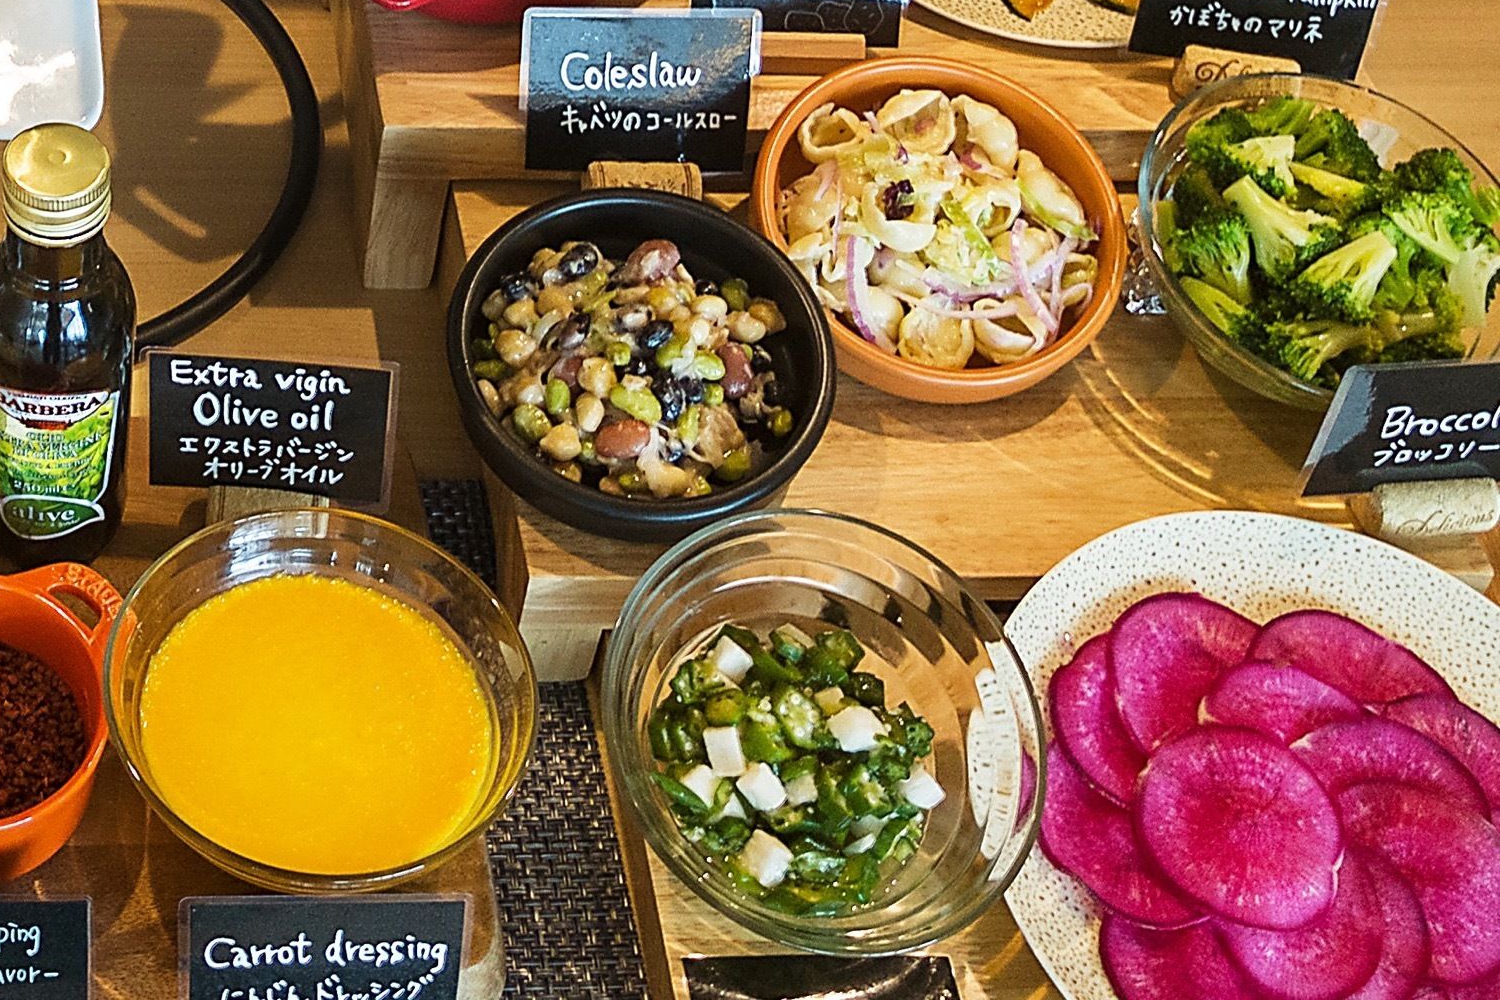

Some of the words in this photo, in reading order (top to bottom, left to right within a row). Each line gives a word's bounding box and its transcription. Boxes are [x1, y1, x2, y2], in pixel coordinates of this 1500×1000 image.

[560, 51, 702, 92] Coleslaw
[170, 359, 263, 390] Extra
[274, 368, 351, 401] vigin
[192, 391, 279, 429] Olive
[290, 400, 335, 432] oil
[178, 436, 355, 463] エクストラバージン
[203, 932, 313, 970] Carrot
[324, 929, 449, 974] dressing
